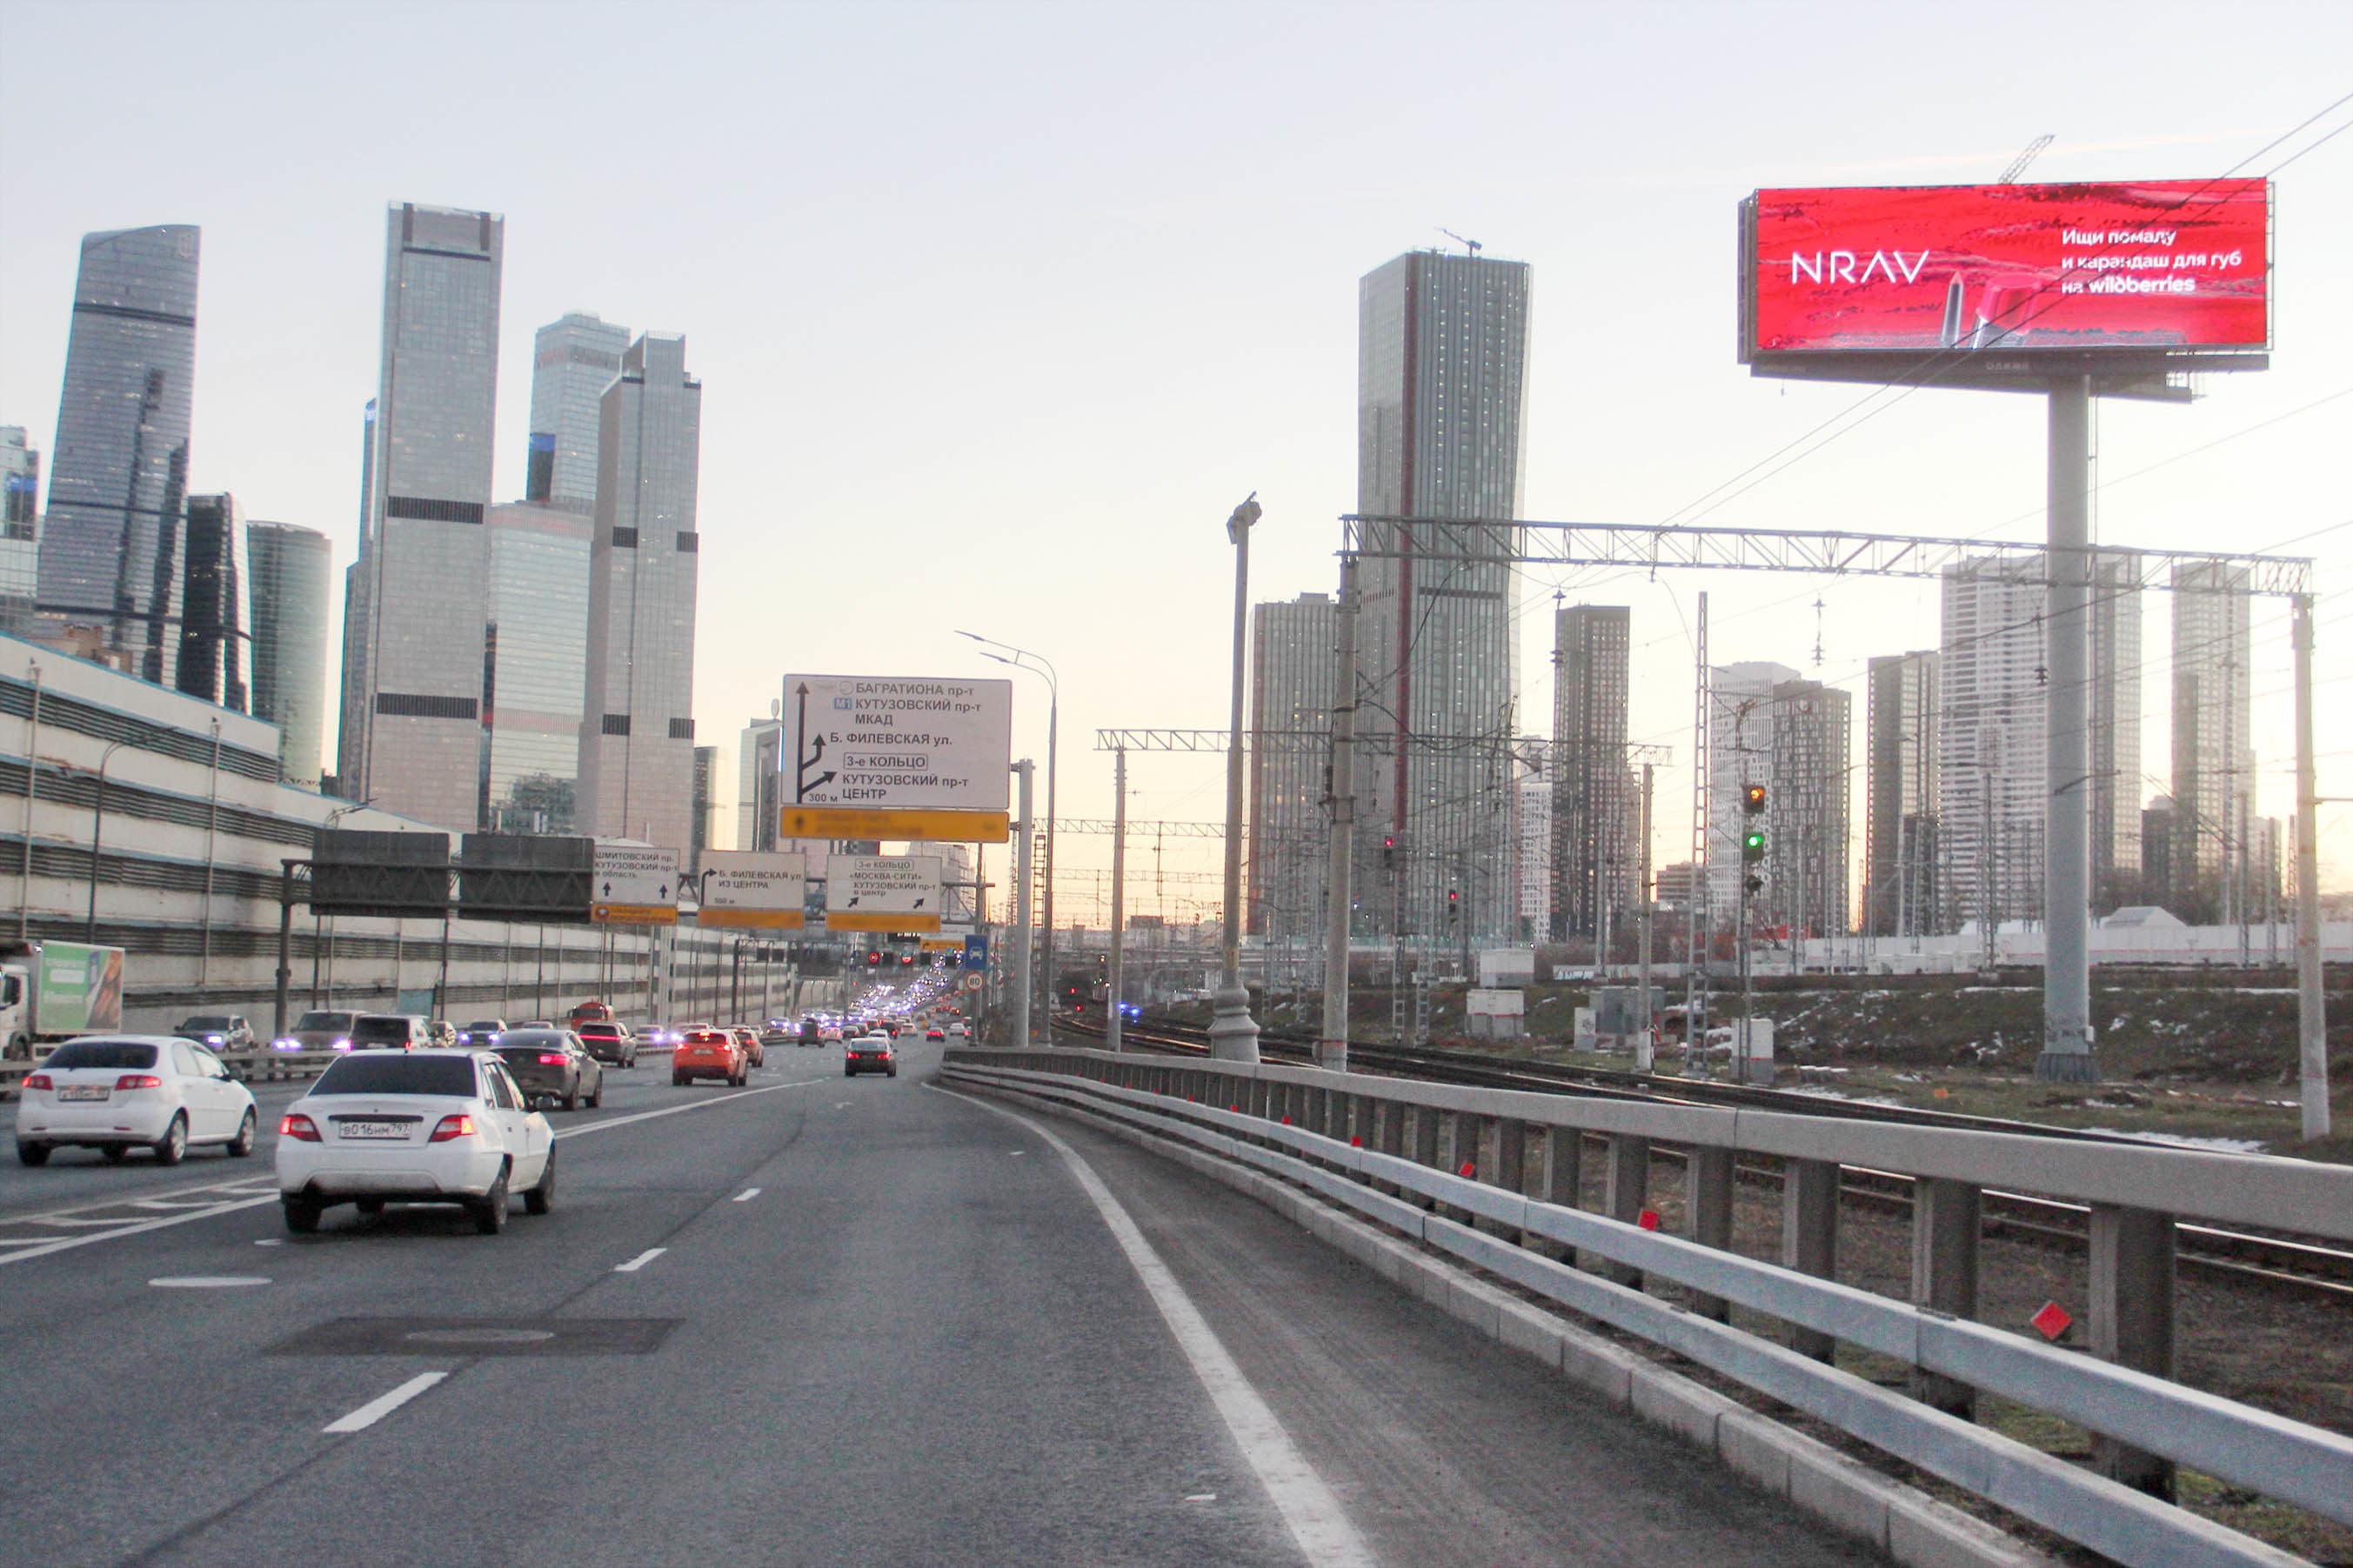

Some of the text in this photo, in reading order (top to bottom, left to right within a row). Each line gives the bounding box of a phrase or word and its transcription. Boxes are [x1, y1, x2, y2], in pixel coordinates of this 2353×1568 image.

[2062, 230, 2103, 246] Ищи
[1792, 250, 1929, 284] NRAV
[2062, 250, 2243, 271] и карандаш для губ
[2062, 274, 2196, 293] на wildberries
[856, 683, 974, 697] БАГРАТИОНА пр-т
[855, 697, 951, 711] КУТУЗОВСКИЙ
[955, 703, 981, 713] пр-т
[855, 714, 893, 726] МКАД
[830, 732, 953, 747] Б. ФИЛЕВСКАЯ ул.
[846, 756, 926, 770] 3-е КОЛЬЦО
[842, 773, 969, 789] КУТУЗОВСКИЙ пр-т
[809, 793, 826, 802] 300
[842, 789, 887, 801] ЦЕНТР
[595, 862, 658, 871] КУТУЗОВСКИЙ
[873, 861, 910, 870] КОЛЬЦО
[731, 871, 788, 879] ФИЛЕВСКАЯ
[733, 881, 769, 890] ЦЕНТРА
[854, 881, 917, 890] КУТУЗОВСКИЙ
